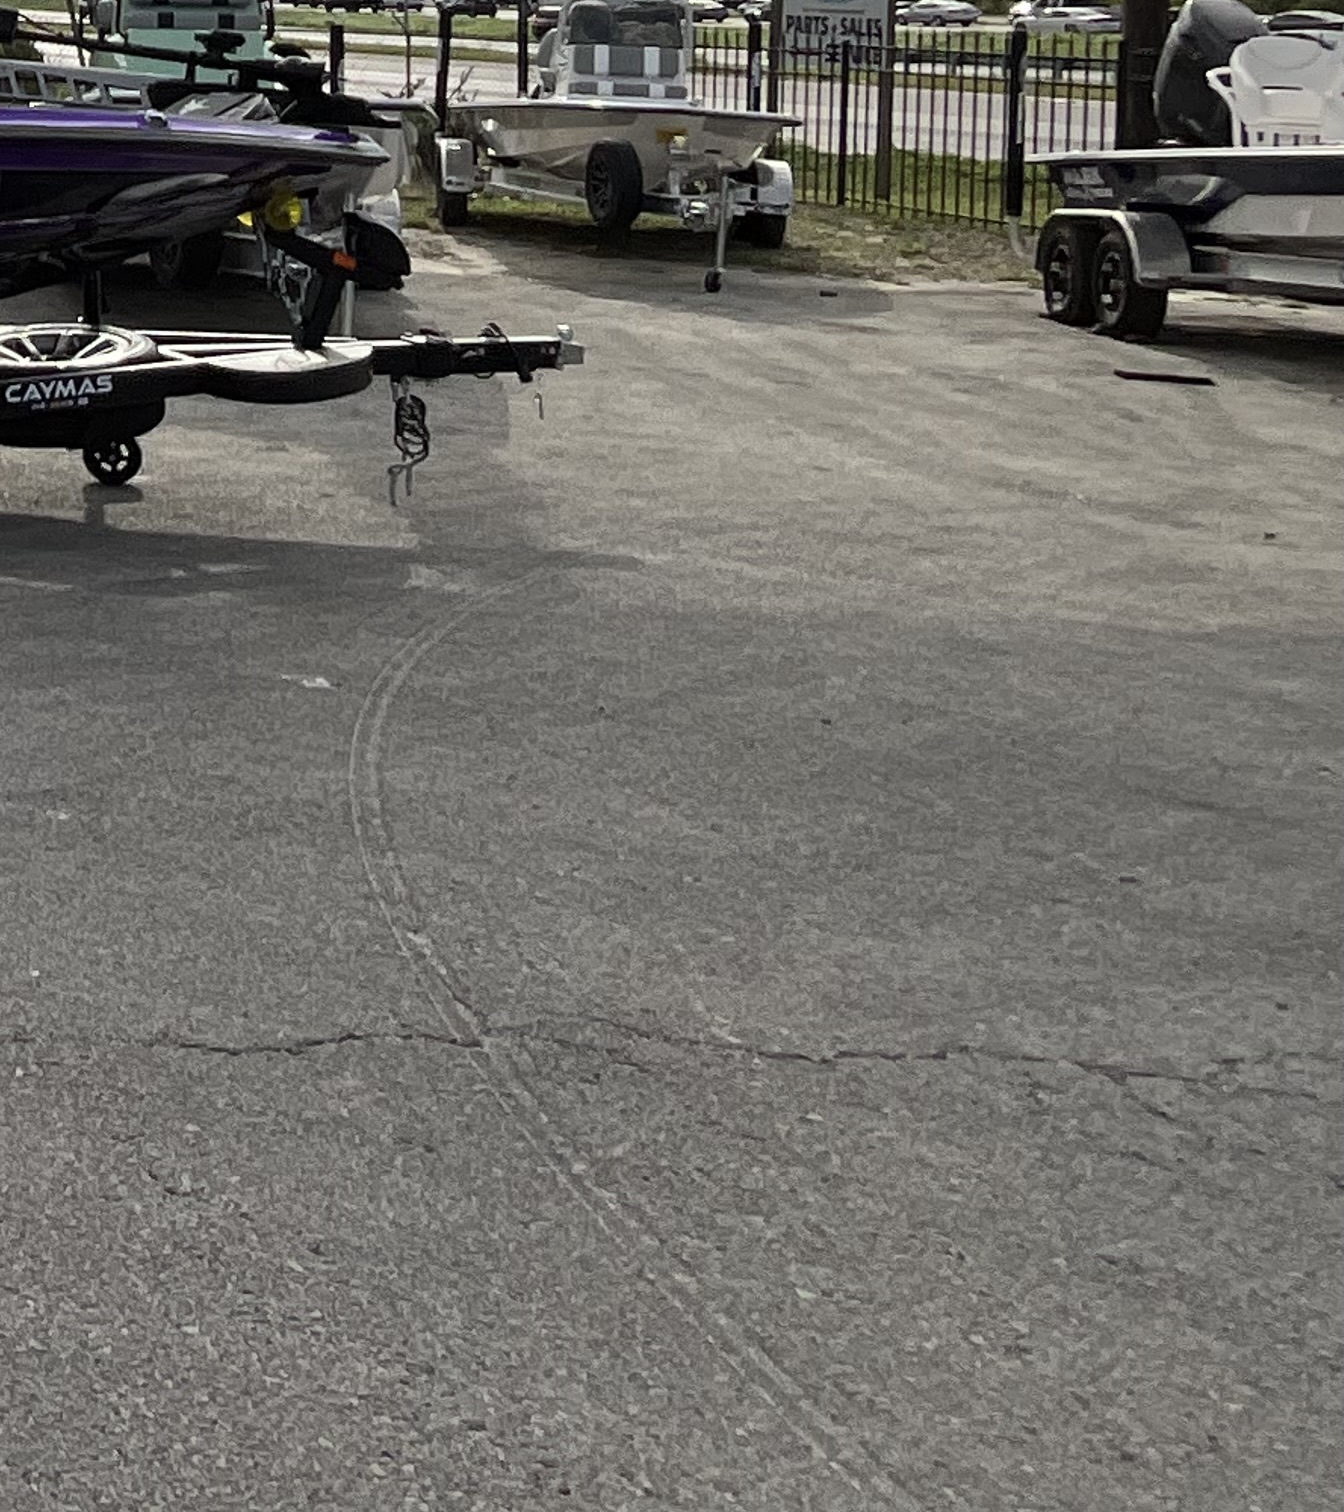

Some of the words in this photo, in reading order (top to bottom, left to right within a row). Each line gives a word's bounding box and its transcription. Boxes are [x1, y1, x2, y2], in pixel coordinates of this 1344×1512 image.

[786, 15, 830, 36] PARTS
[840, 17, 882, 38] SALES
[4, 374, 114, 404] CAYMAS
